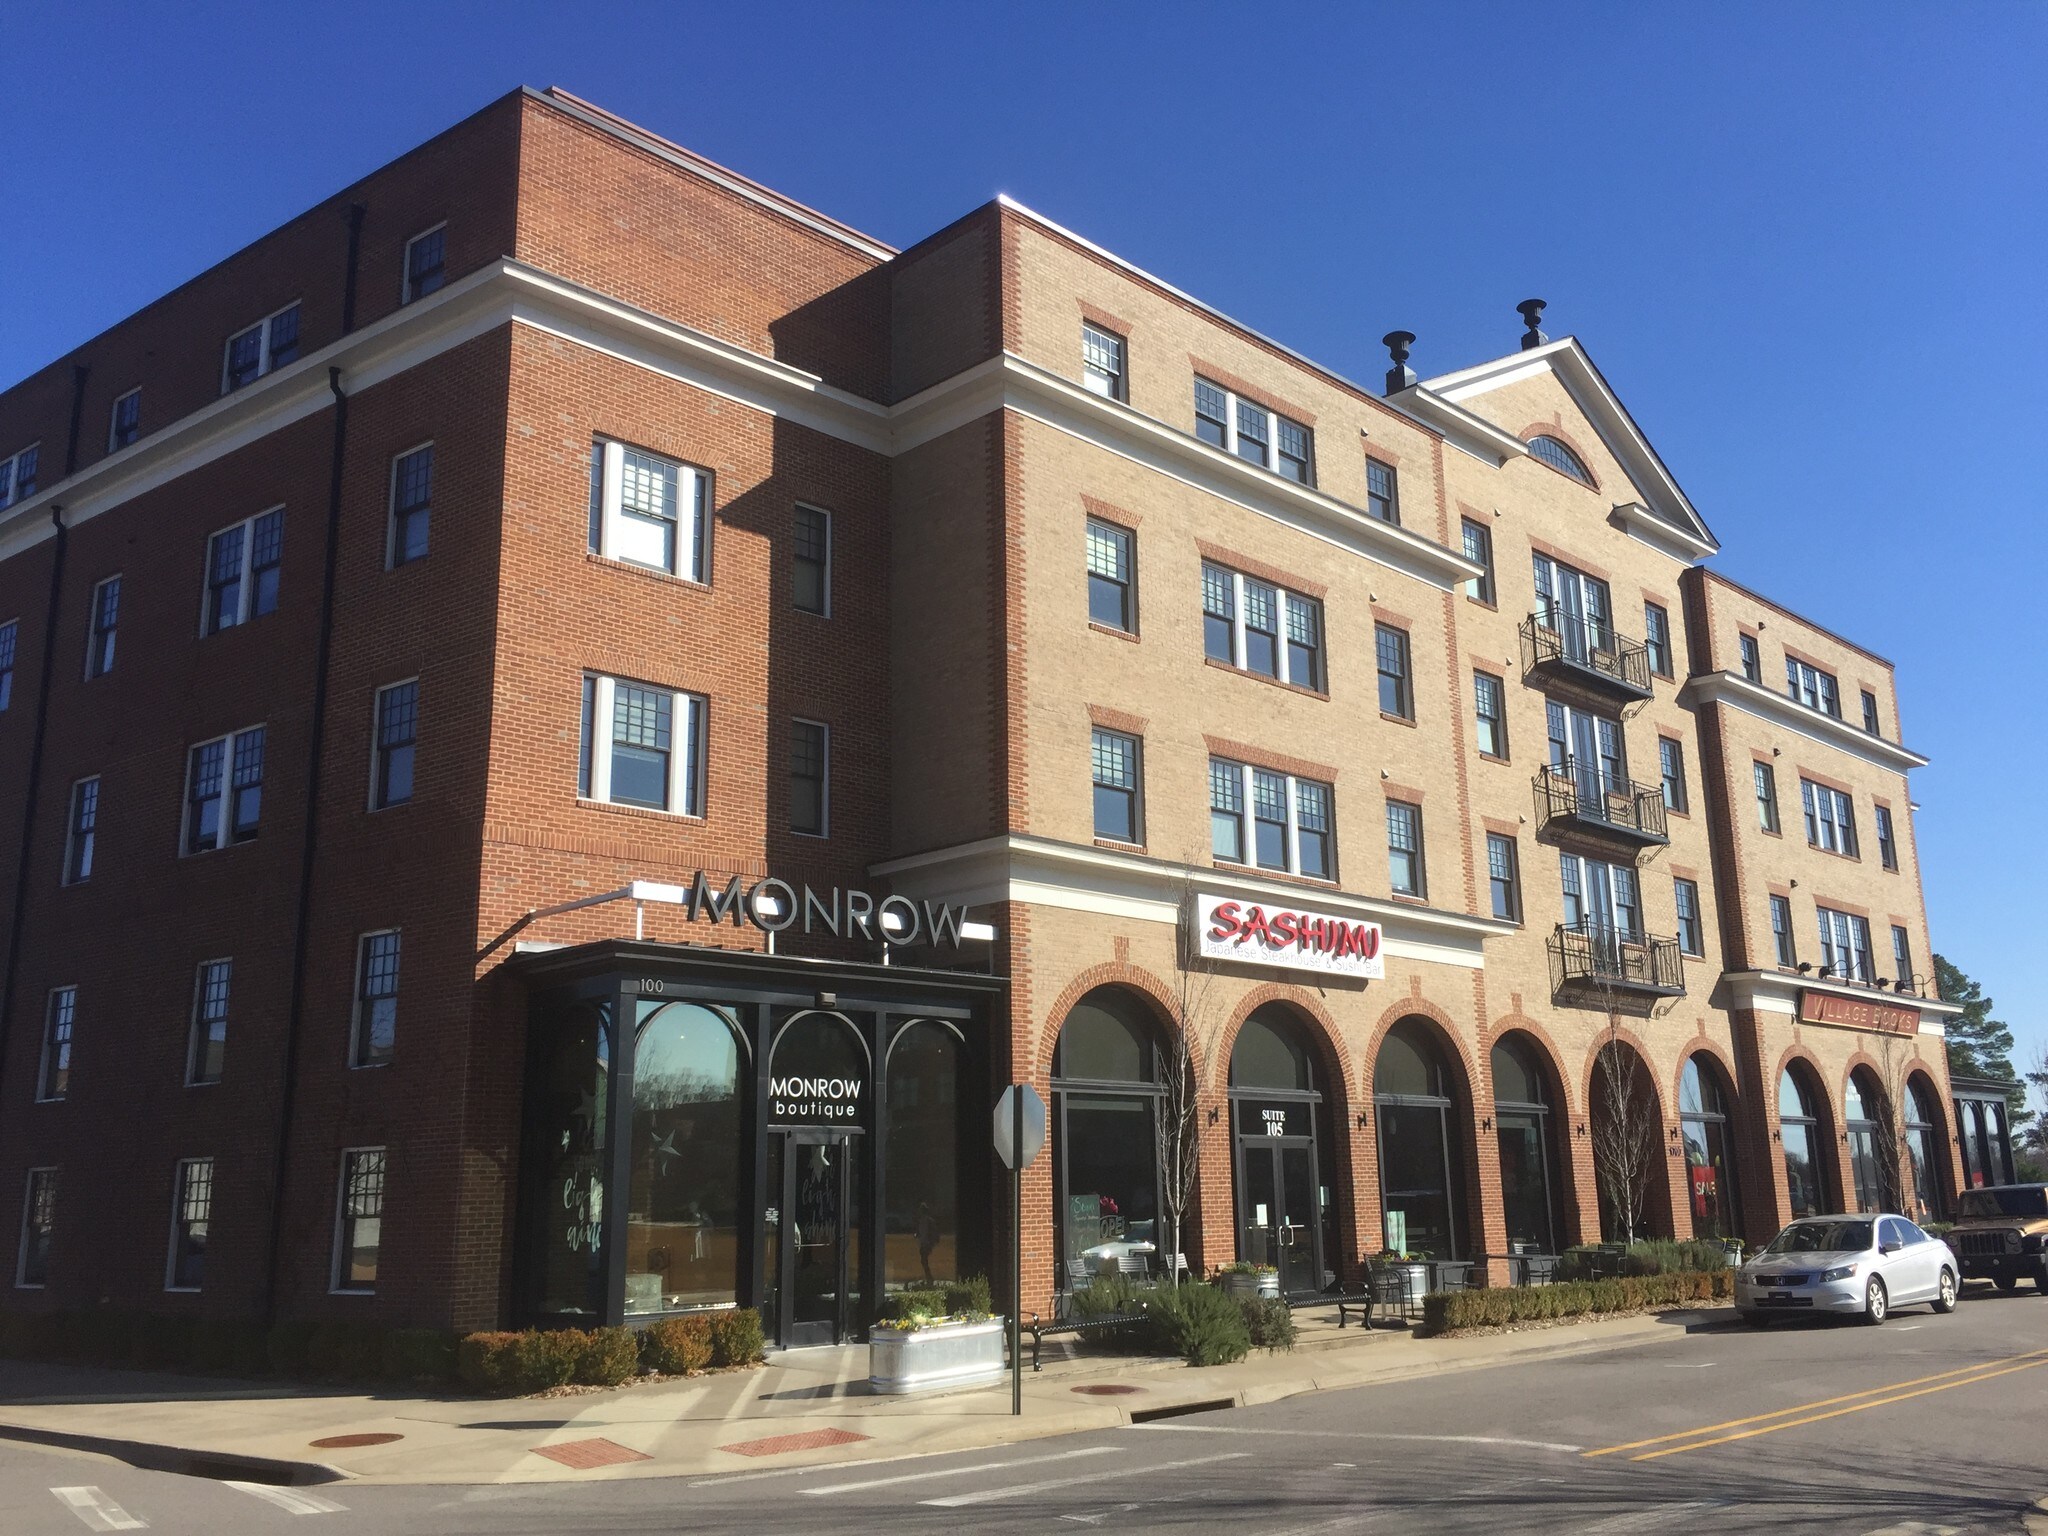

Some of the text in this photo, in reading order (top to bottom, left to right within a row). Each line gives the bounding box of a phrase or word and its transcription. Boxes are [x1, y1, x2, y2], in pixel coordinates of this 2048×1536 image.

[686, 870, 968, 950] MONROW
[1212, 901, 1379, 960] SASHIMI
[1205, 940, 1257, 958] Japanese
[1262, 947, 1321, 969] Steakhouse
[1366, 961, 1381, 975] Bar
[641, 978, 664, 993] 100
[1814, 996, 1913, 1030] VILLAGE BOOKS
[770, 1077, 861, 1099] MONROW
[775, 1100, 855, 1119] boutique
[1262, 1109, 1286, 1121] SUITE
[1266, 1121, 1284, 1137] 105
